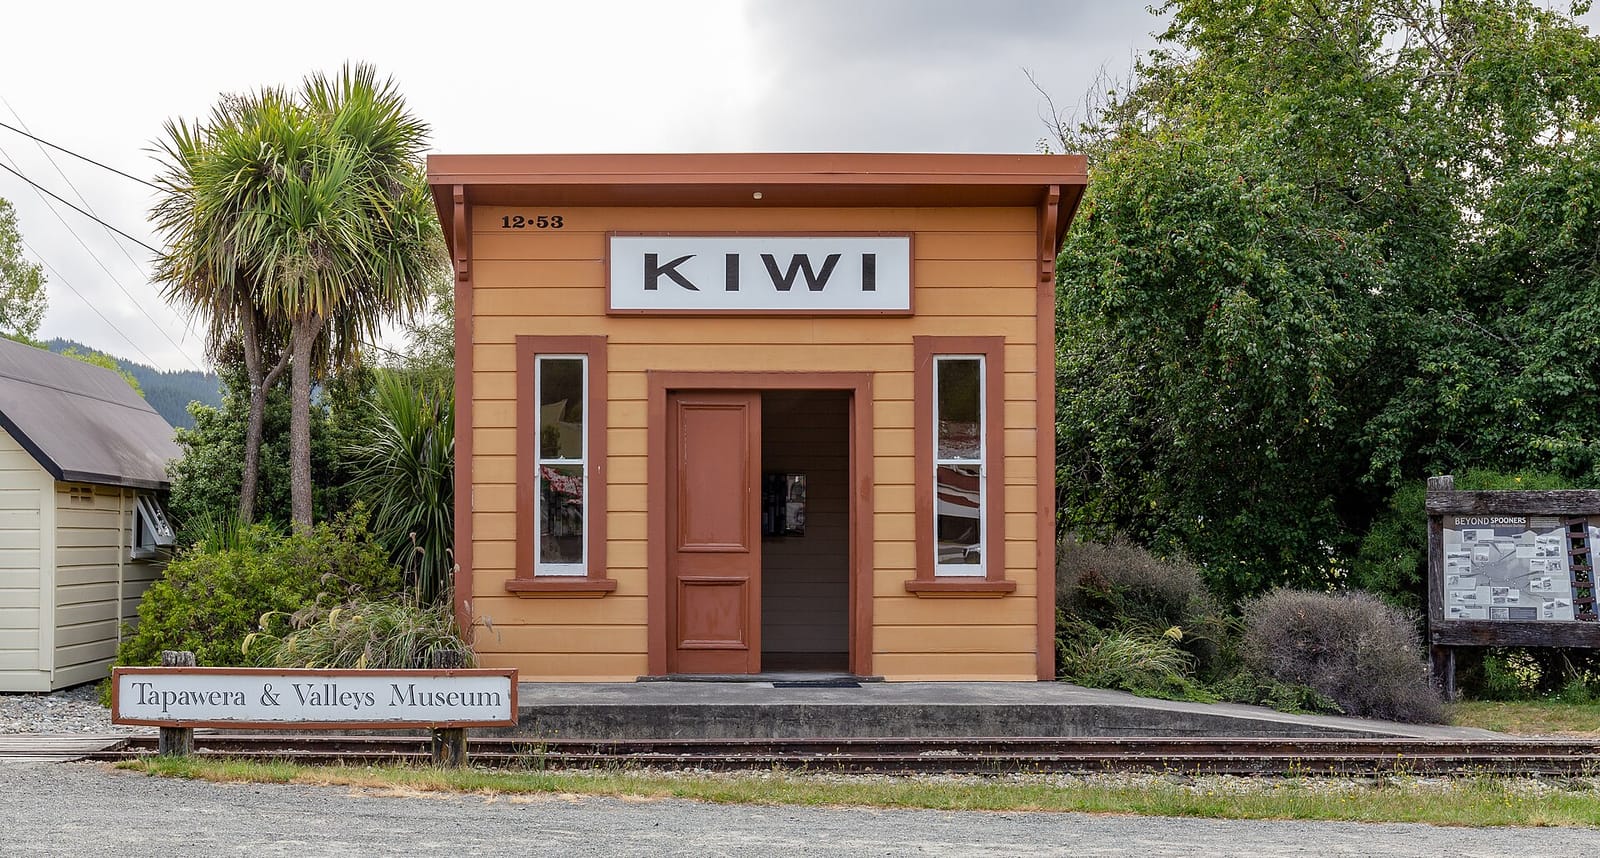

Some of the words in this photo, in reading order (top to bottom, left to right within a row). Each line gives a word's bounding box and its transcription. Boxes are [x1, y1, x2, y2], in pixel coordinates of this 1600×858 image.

[643, 253, 876, 292] KIWI
[1455, 517, 1490, 526] BEYOND
[1490, 516, 1527, 524] SPOONERS
[131, 682, 246, 713] Tapawera
[259, 683, 281, 707] &
[291, 683, 375, 711] Valleys
[388, 683, 501, 707] Museum
